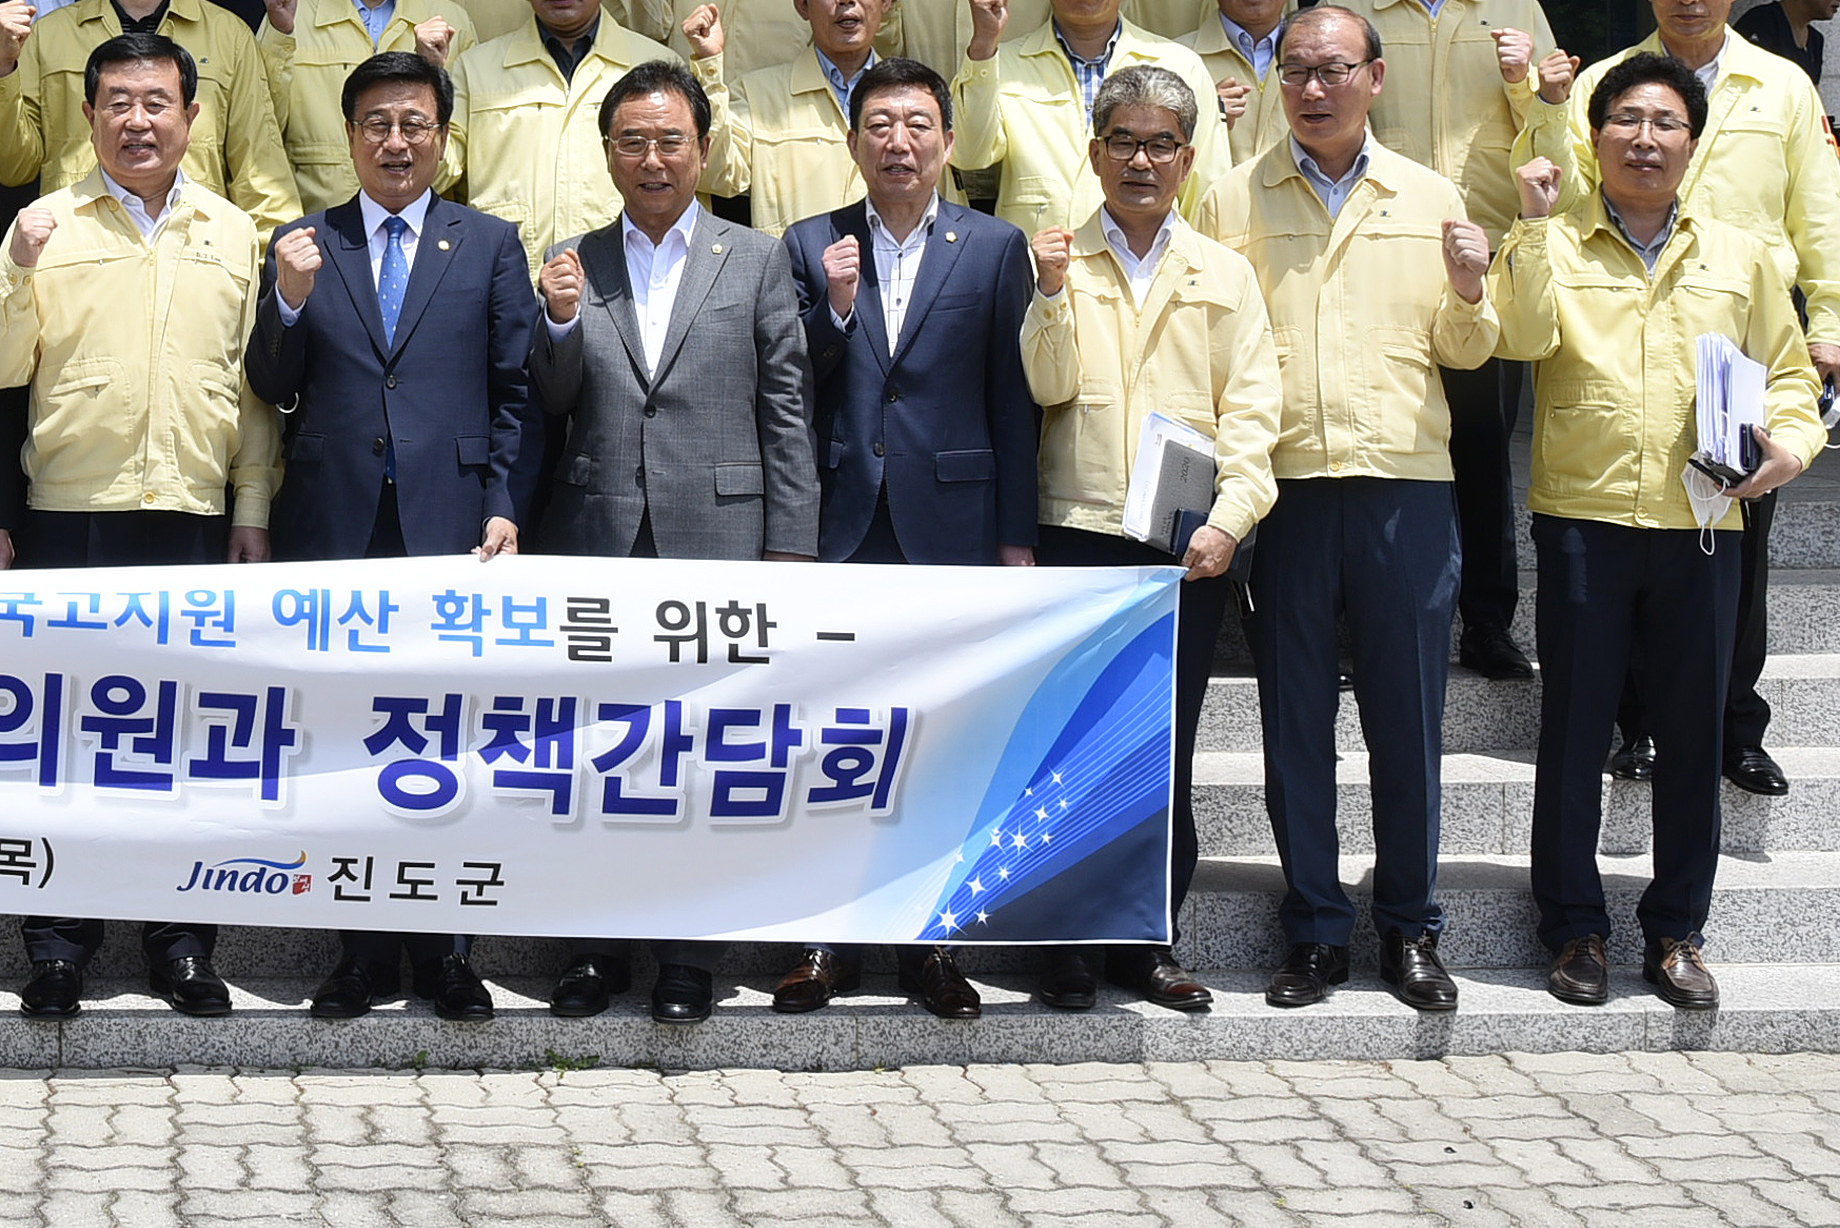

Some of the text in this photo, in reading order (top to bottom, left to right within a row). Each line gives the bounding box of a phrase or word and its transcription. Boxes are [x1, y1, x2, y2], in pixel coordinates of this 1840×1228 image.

[272, 588, 400, 653] 예산
[431, 589, 619, 663] 확보를
[653, 600, 777, 665] 위한
[362, 692, 911, 818] 정책간담회
[176, 860, 289, 895] Jindo
[327, 856, 505, 906] 진도군
